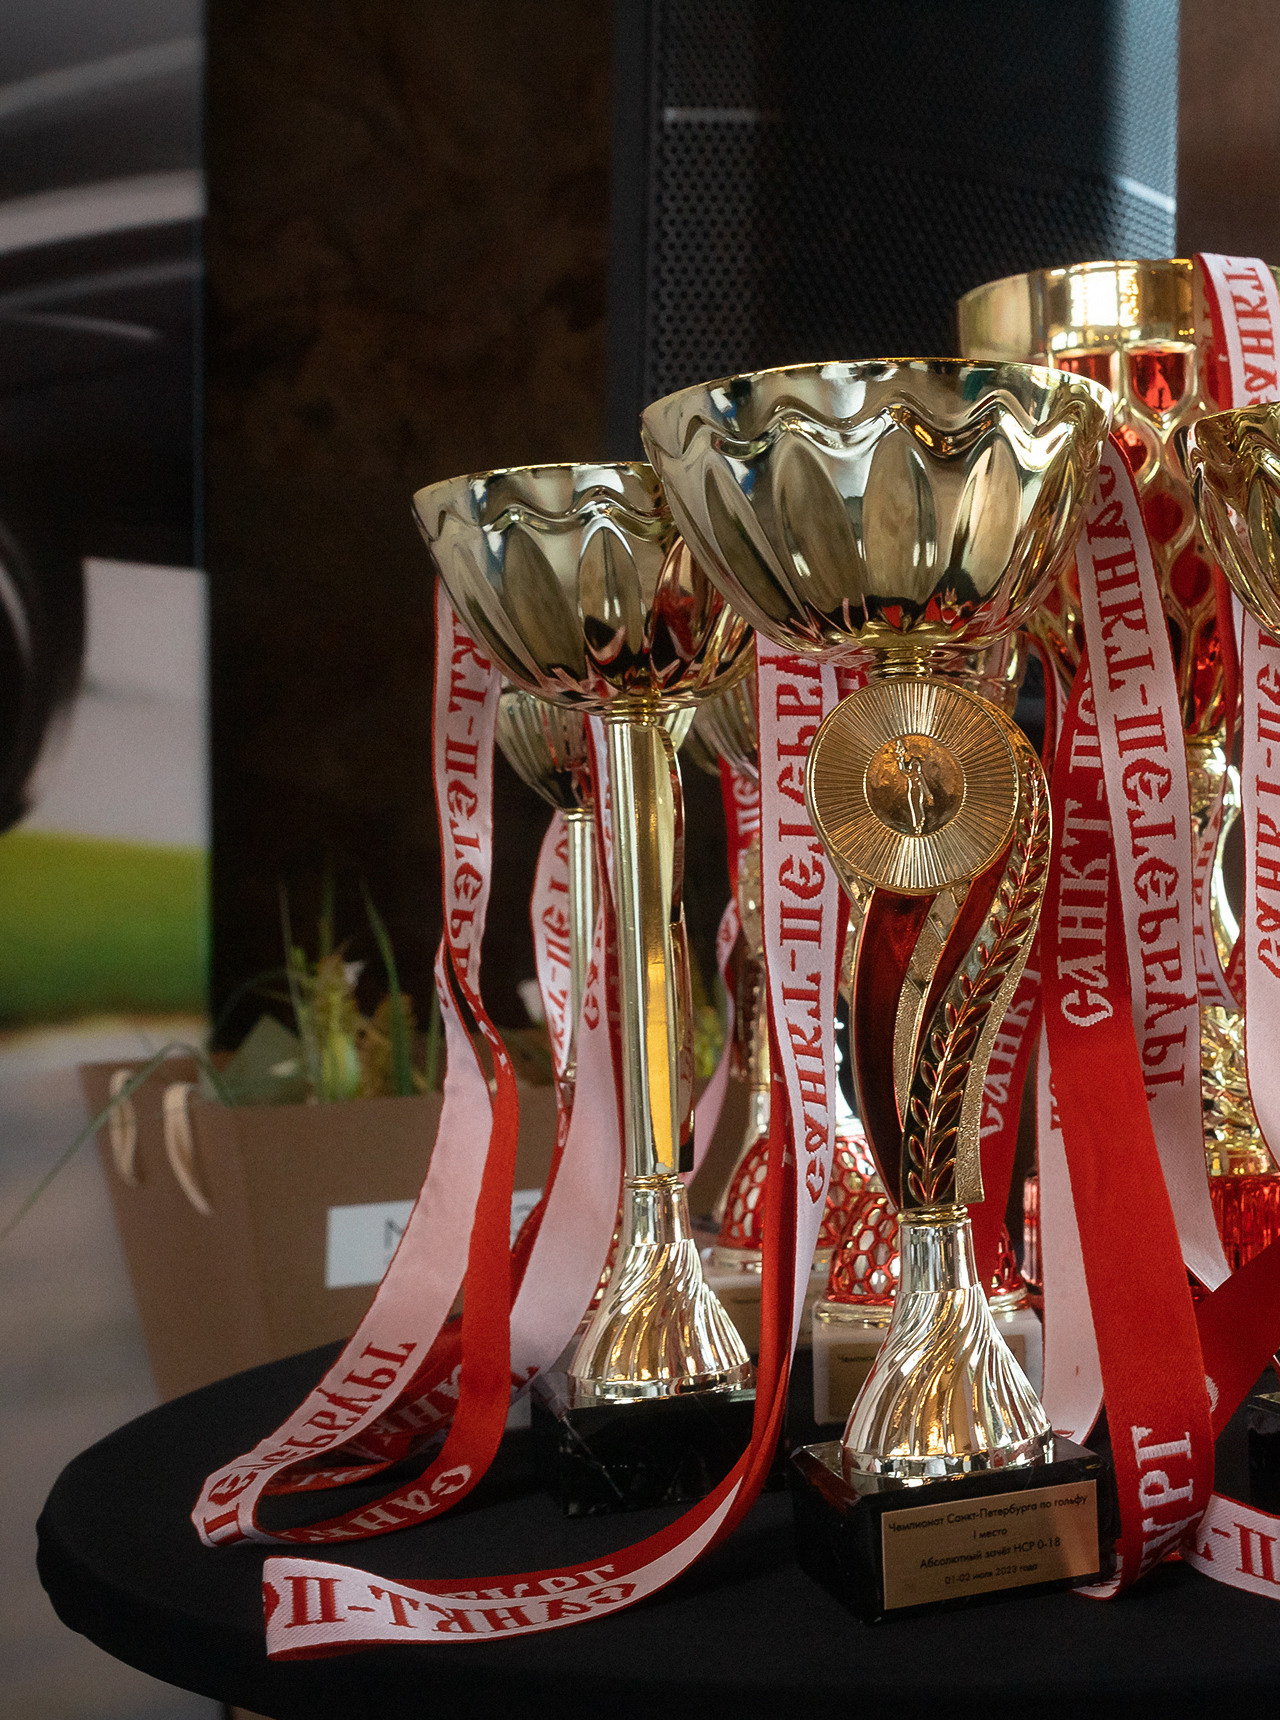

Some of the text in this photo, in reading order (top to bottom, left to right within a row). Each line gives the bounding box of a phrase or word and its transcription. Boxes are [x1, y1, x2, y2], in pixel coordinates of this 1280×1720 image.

[888, 1493, 1088, 1533] Чемпионат Санкт-Петербурга по гольфу
[978, 1527, 1008, 1539] место
[919, 1551, 983, 1569] Абсолютный
[984, 1545, 1012, 1559] зачёт
[1036, 1536, 1062, 1549] 0-18
[944, 1572, 972, 1585] 01-02
[995, 1564, 1018, 1576] 2023
